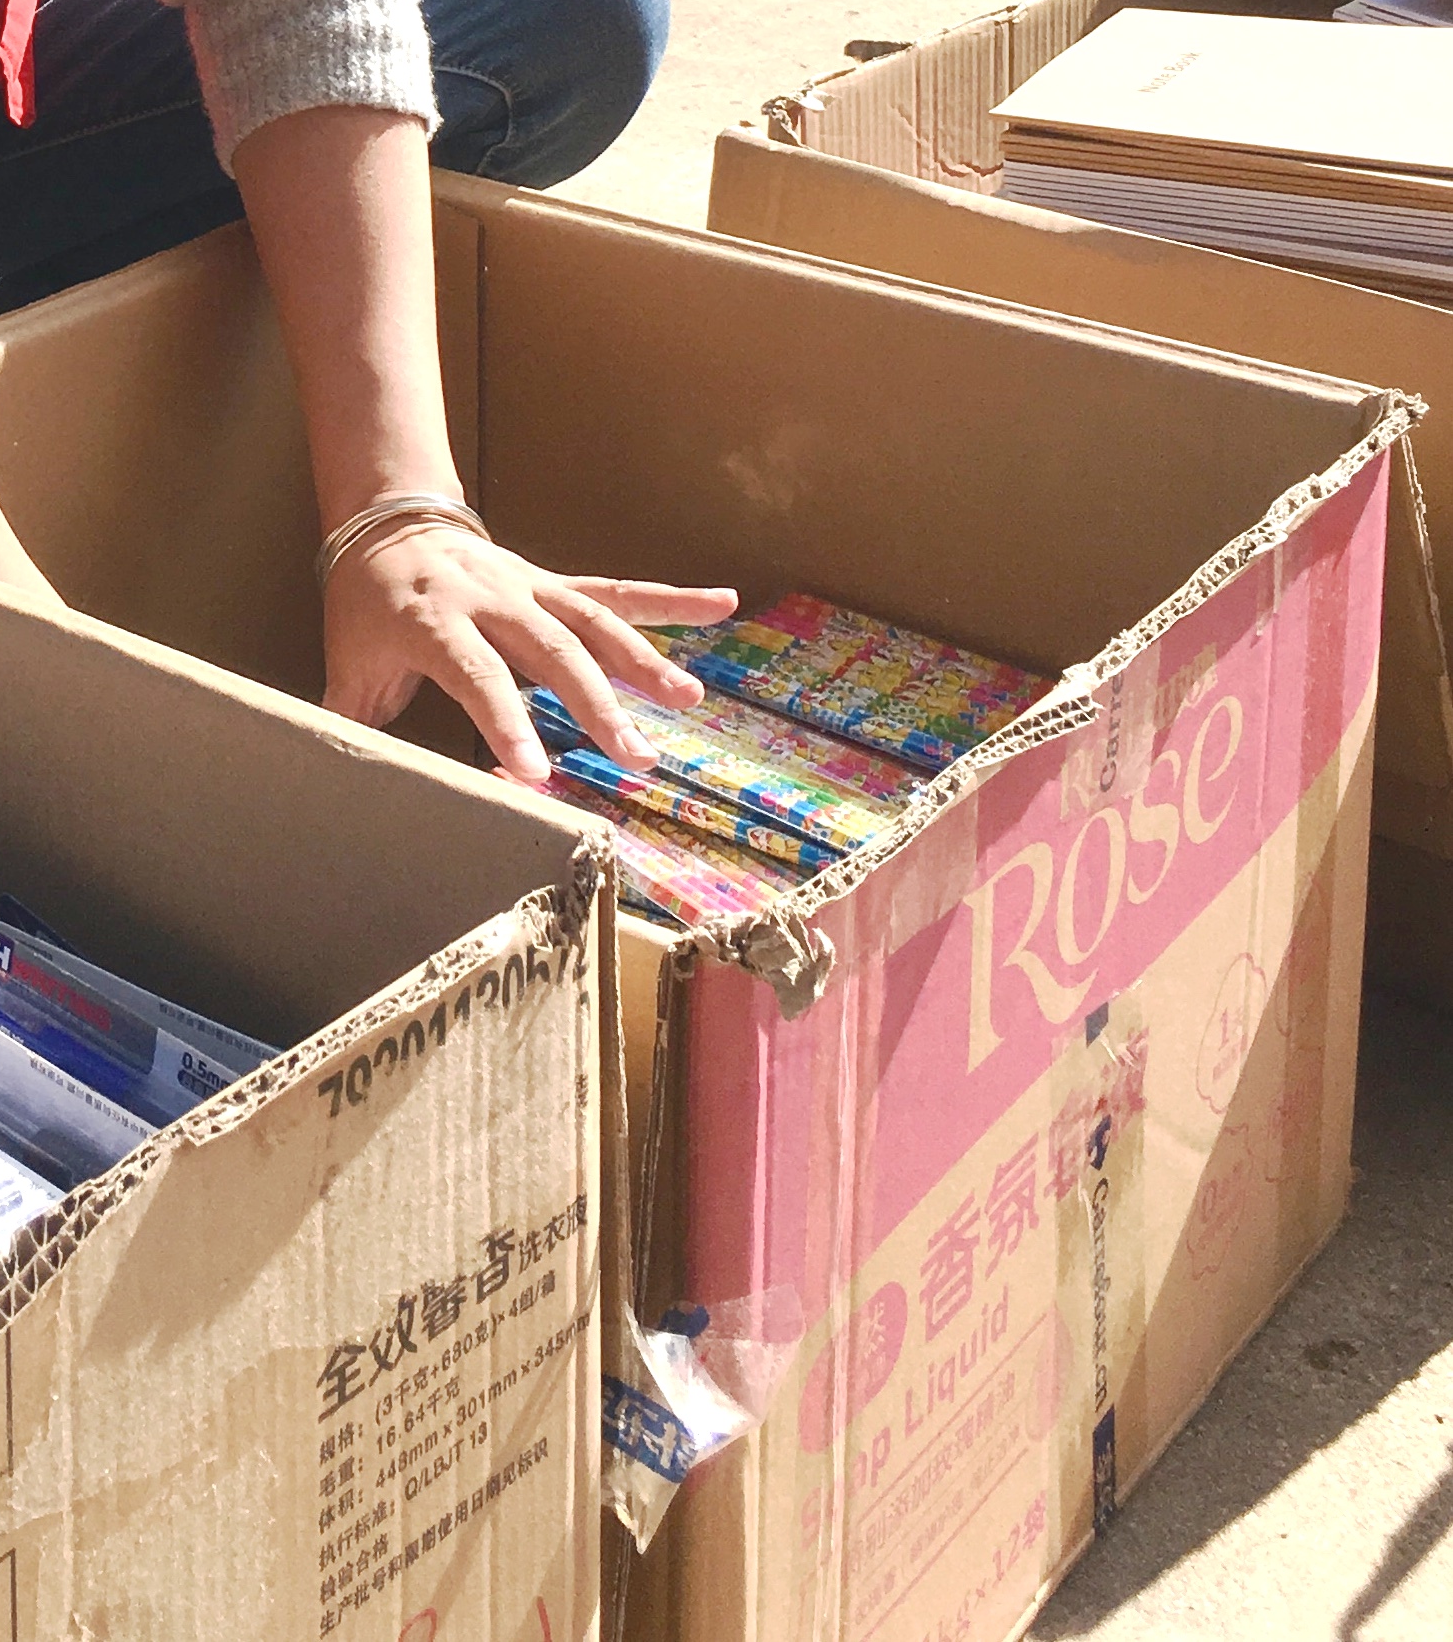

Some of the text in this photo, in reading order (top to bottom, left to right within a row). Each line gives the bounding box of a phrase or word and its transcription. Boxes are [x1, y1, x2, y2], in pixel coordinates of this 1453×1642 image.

[963, 696, 1245, 1073] Rose
[800, 1425, 892, 1553] Sap
[904, 1285, 1009, 1440] Liquid
